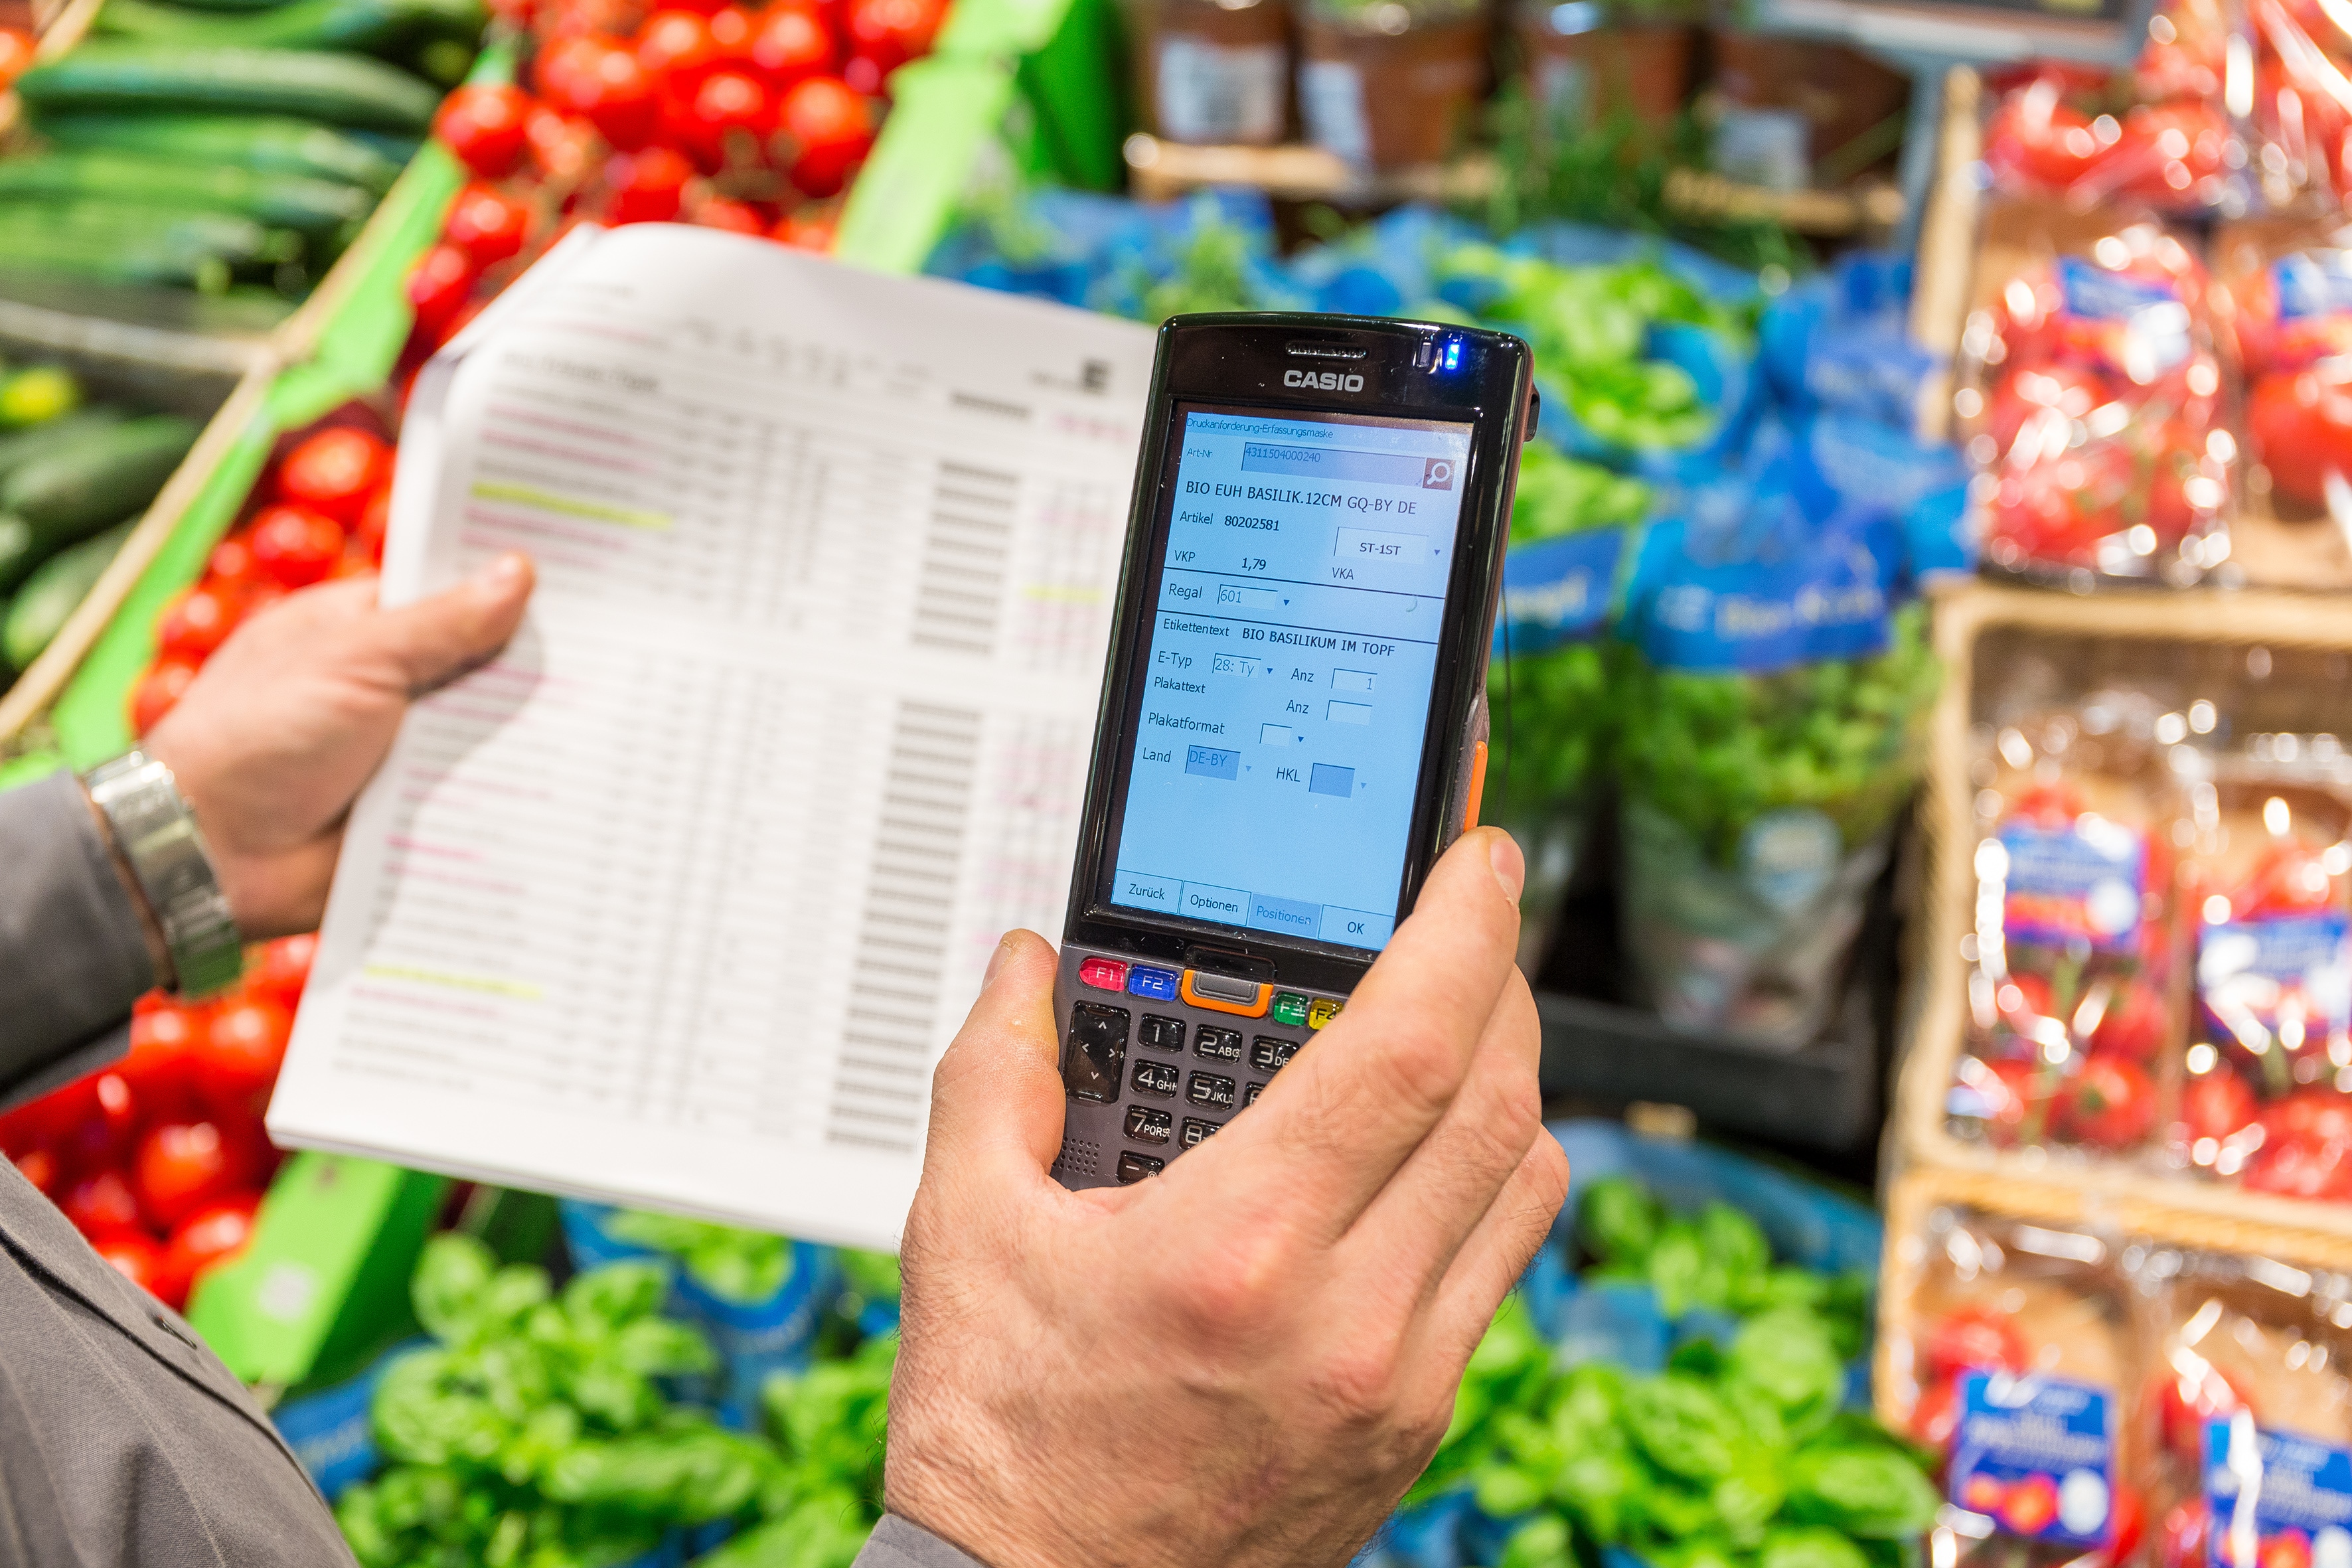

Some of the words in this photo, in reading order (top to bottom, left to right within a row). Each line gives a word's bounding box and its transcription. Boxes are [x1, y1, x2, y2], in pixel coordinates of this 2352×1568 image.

[1283, 369, 1364, 392] CASIO
[1186, 418, 1334, 439] Druckanforderung-Erfassungsmaske
[1186, 447, 1213, 458] Art-Nr
[1245, 447, 1321, 463] 4311504000240
[1186, 481, 1210, 495] BIO
[1215, 483, 1242, 498] EUH
[1247, 487, 1342, 507] BASILIK.12CM
[1347, 497, 1393, 513] GQ-BY
[1397, 501, 1417, 514] DE
[1179, 511, 1214, 525] Artikel
[1224, 515, 1280, 531] 80202581
[1359, 542, 1402, 556] ST-1ST
[1174, 550, 1196, 562] VKP
[1241, 558, 1267, 571] 1,79
[1332, 567, 1354, 580] VKA
[1168, 583, 1203, 599] Regal
[1219, 589, 1242, 604] 601
[1163, 618, 1229, 637] Etikettentext
[1241, 627, 1265, 642] BIO
[1269, 631, 1337, 650] BASILIKUM
[1341, 639, 1357, 652] IM
[1362, 642, 1396, 657] TOPF
[1158, 651, 1192, 669] E-Typ
[1154, 676, 1206, 694] Plakattext
[1291, 668, 1314, 682] Anz
[1366, 677, 1373, 690] 1
[1286, 700, 1309, 715] Anz
[1148, 712, 1225, 735] Plakatformat
[1142, 747, 1172, 763] Land
[1189, 750, 1228, 767] DE-BY
[1276, 767, 1301, 783] HKL
[1129, 884, 1165, 901] Zurück
[1190, 894, 1239, 914] Optionen
[1255, 905, 1312, 925] Positionen
[1347, 921, 1365, 935] OK
[1095, 967, 1115, 982] F1
[1141, 975, 1164, 990] F2
[1152, 1023, 1161, 1043] 1
[1200, 1032, 1217, 1054] 2
[1256, 1043, 1275, 1064] 3
[1138, 1068, 1154, 1087] 4
[1192, 1078, 1211, 1100] 5
[1131, 1112, 1147, 1133] 7
[1185, 1124, 1203, 1144] 8
